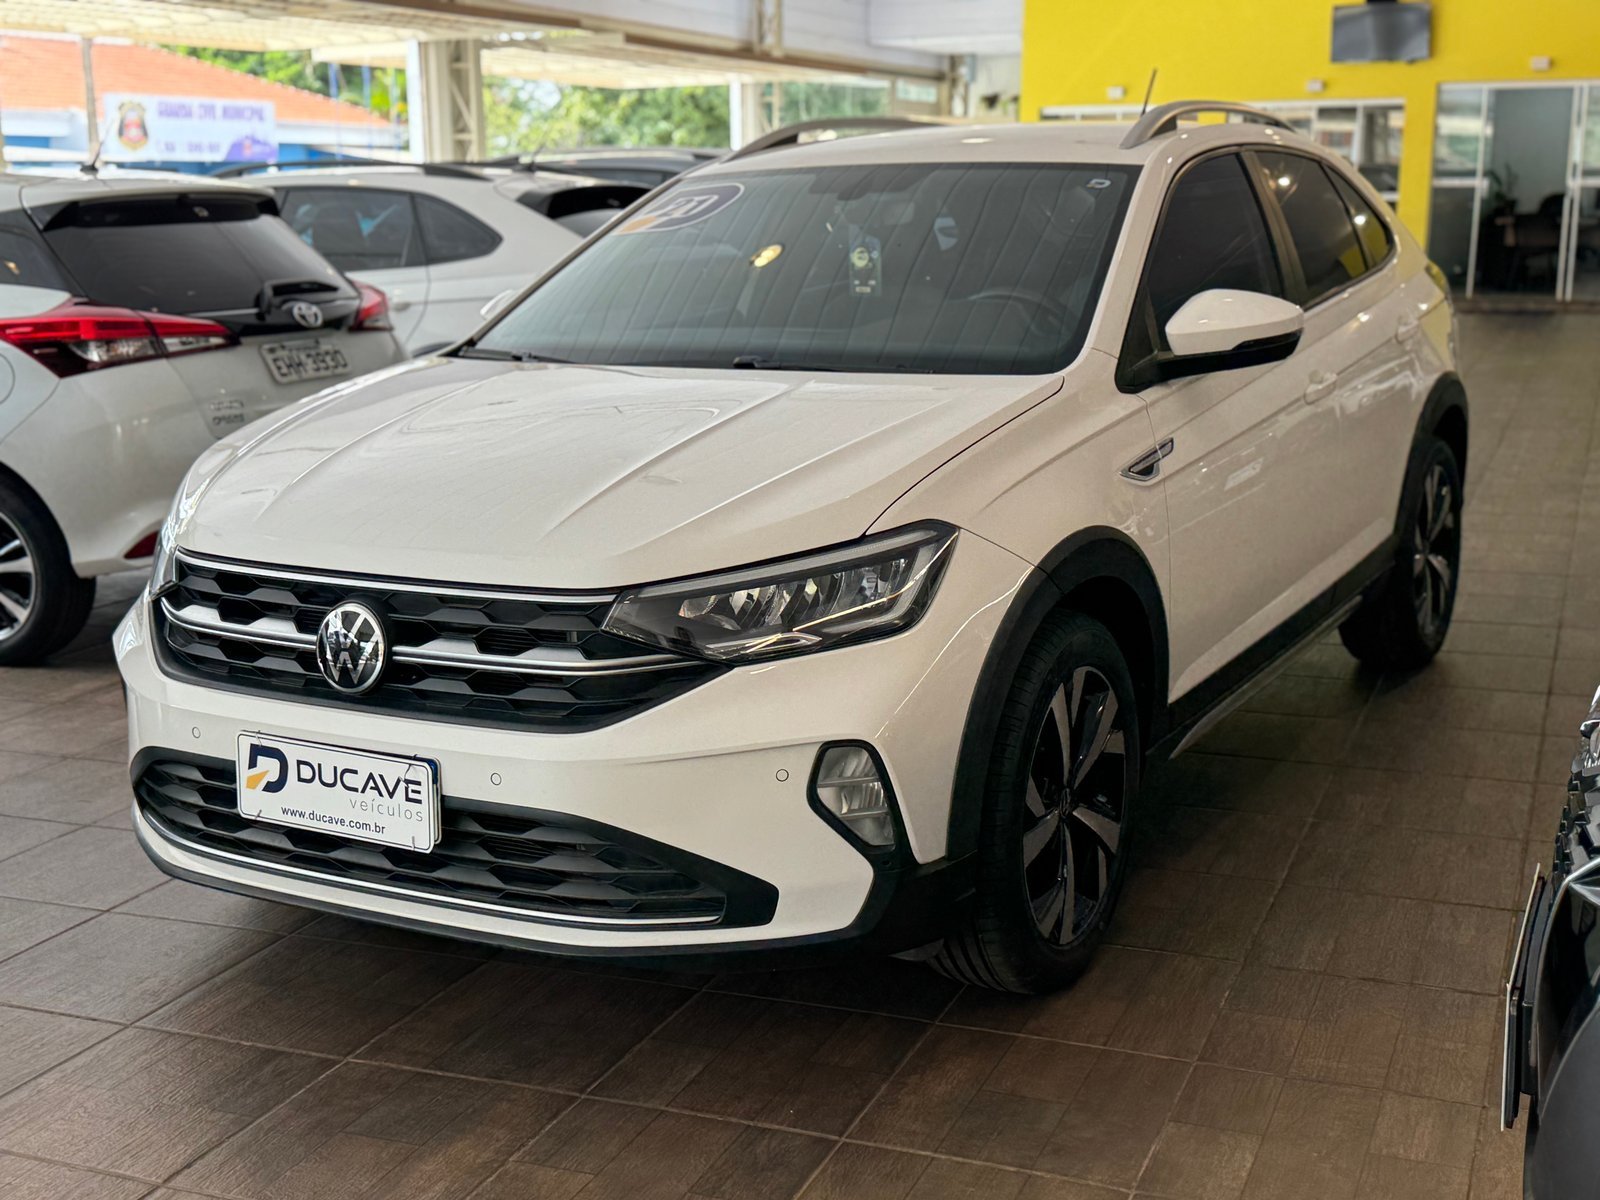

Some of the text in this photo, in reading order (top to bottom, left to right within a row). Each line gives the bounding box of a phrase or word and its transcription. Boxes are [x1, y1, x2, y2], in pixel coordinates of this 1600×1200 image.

[296, 759, 422, 804] DUCAVE
[281, 805, 386, 834] www.ducave.com.br
[349, 798, 423, 822] veículos
